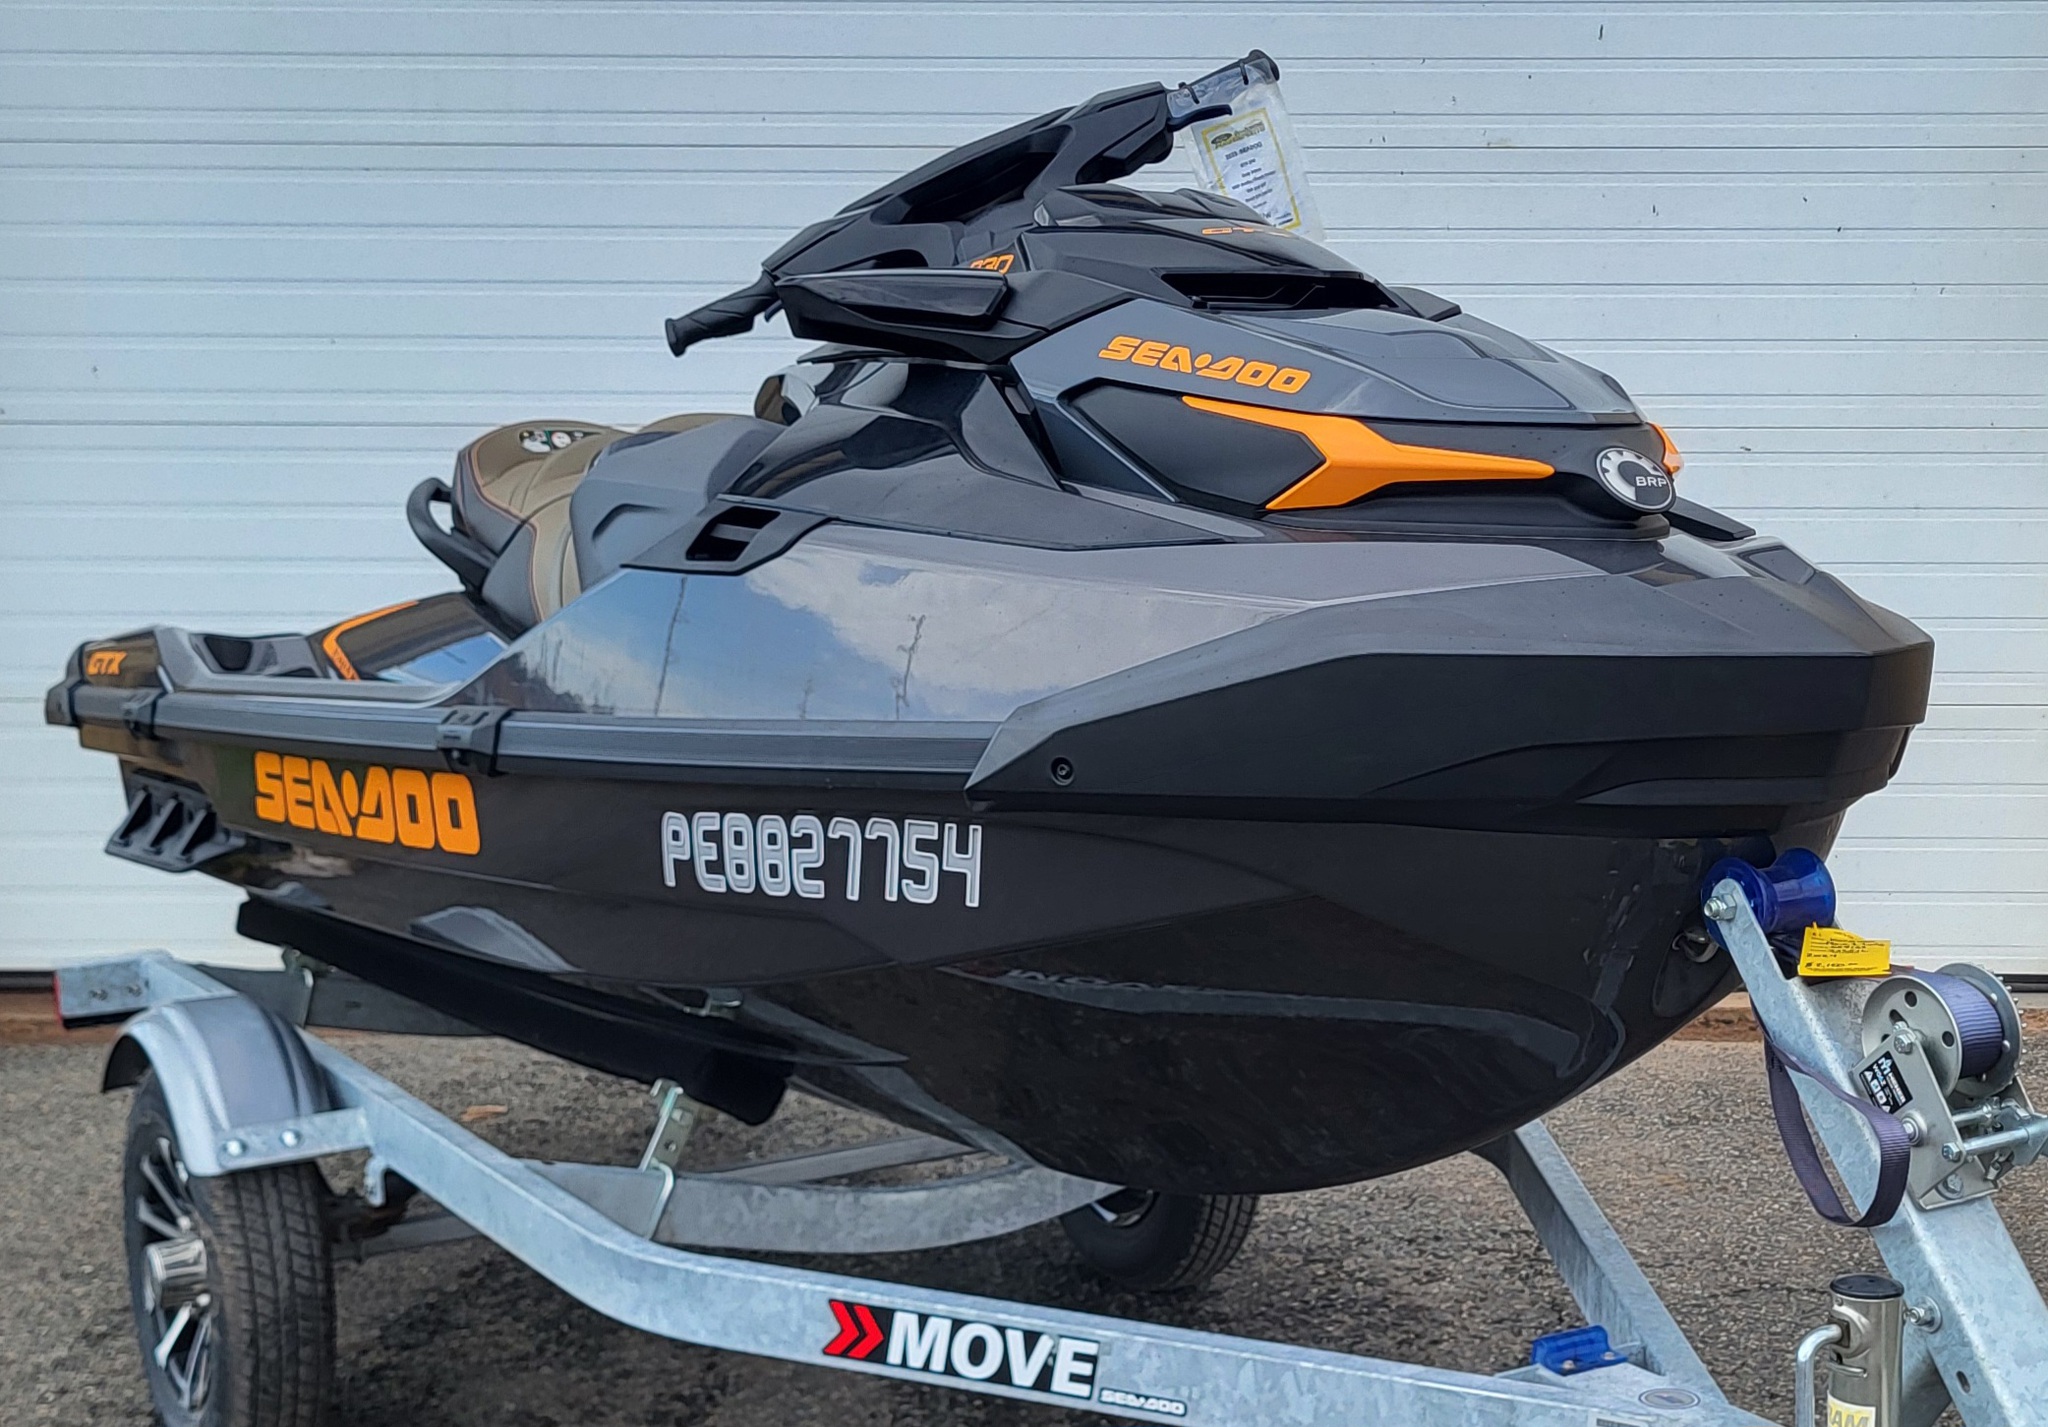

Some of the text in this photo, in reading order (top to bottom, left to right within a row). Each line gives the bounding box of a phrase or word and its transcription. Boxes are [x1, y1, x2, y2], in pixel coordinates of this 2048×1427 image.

[1635, 475, 1668, 488] BRP
[86, 650, 128, 675] GTX
[661, 811, 982, 908] PE8827754
[886, 1310, 1100, 1398] MOVE
